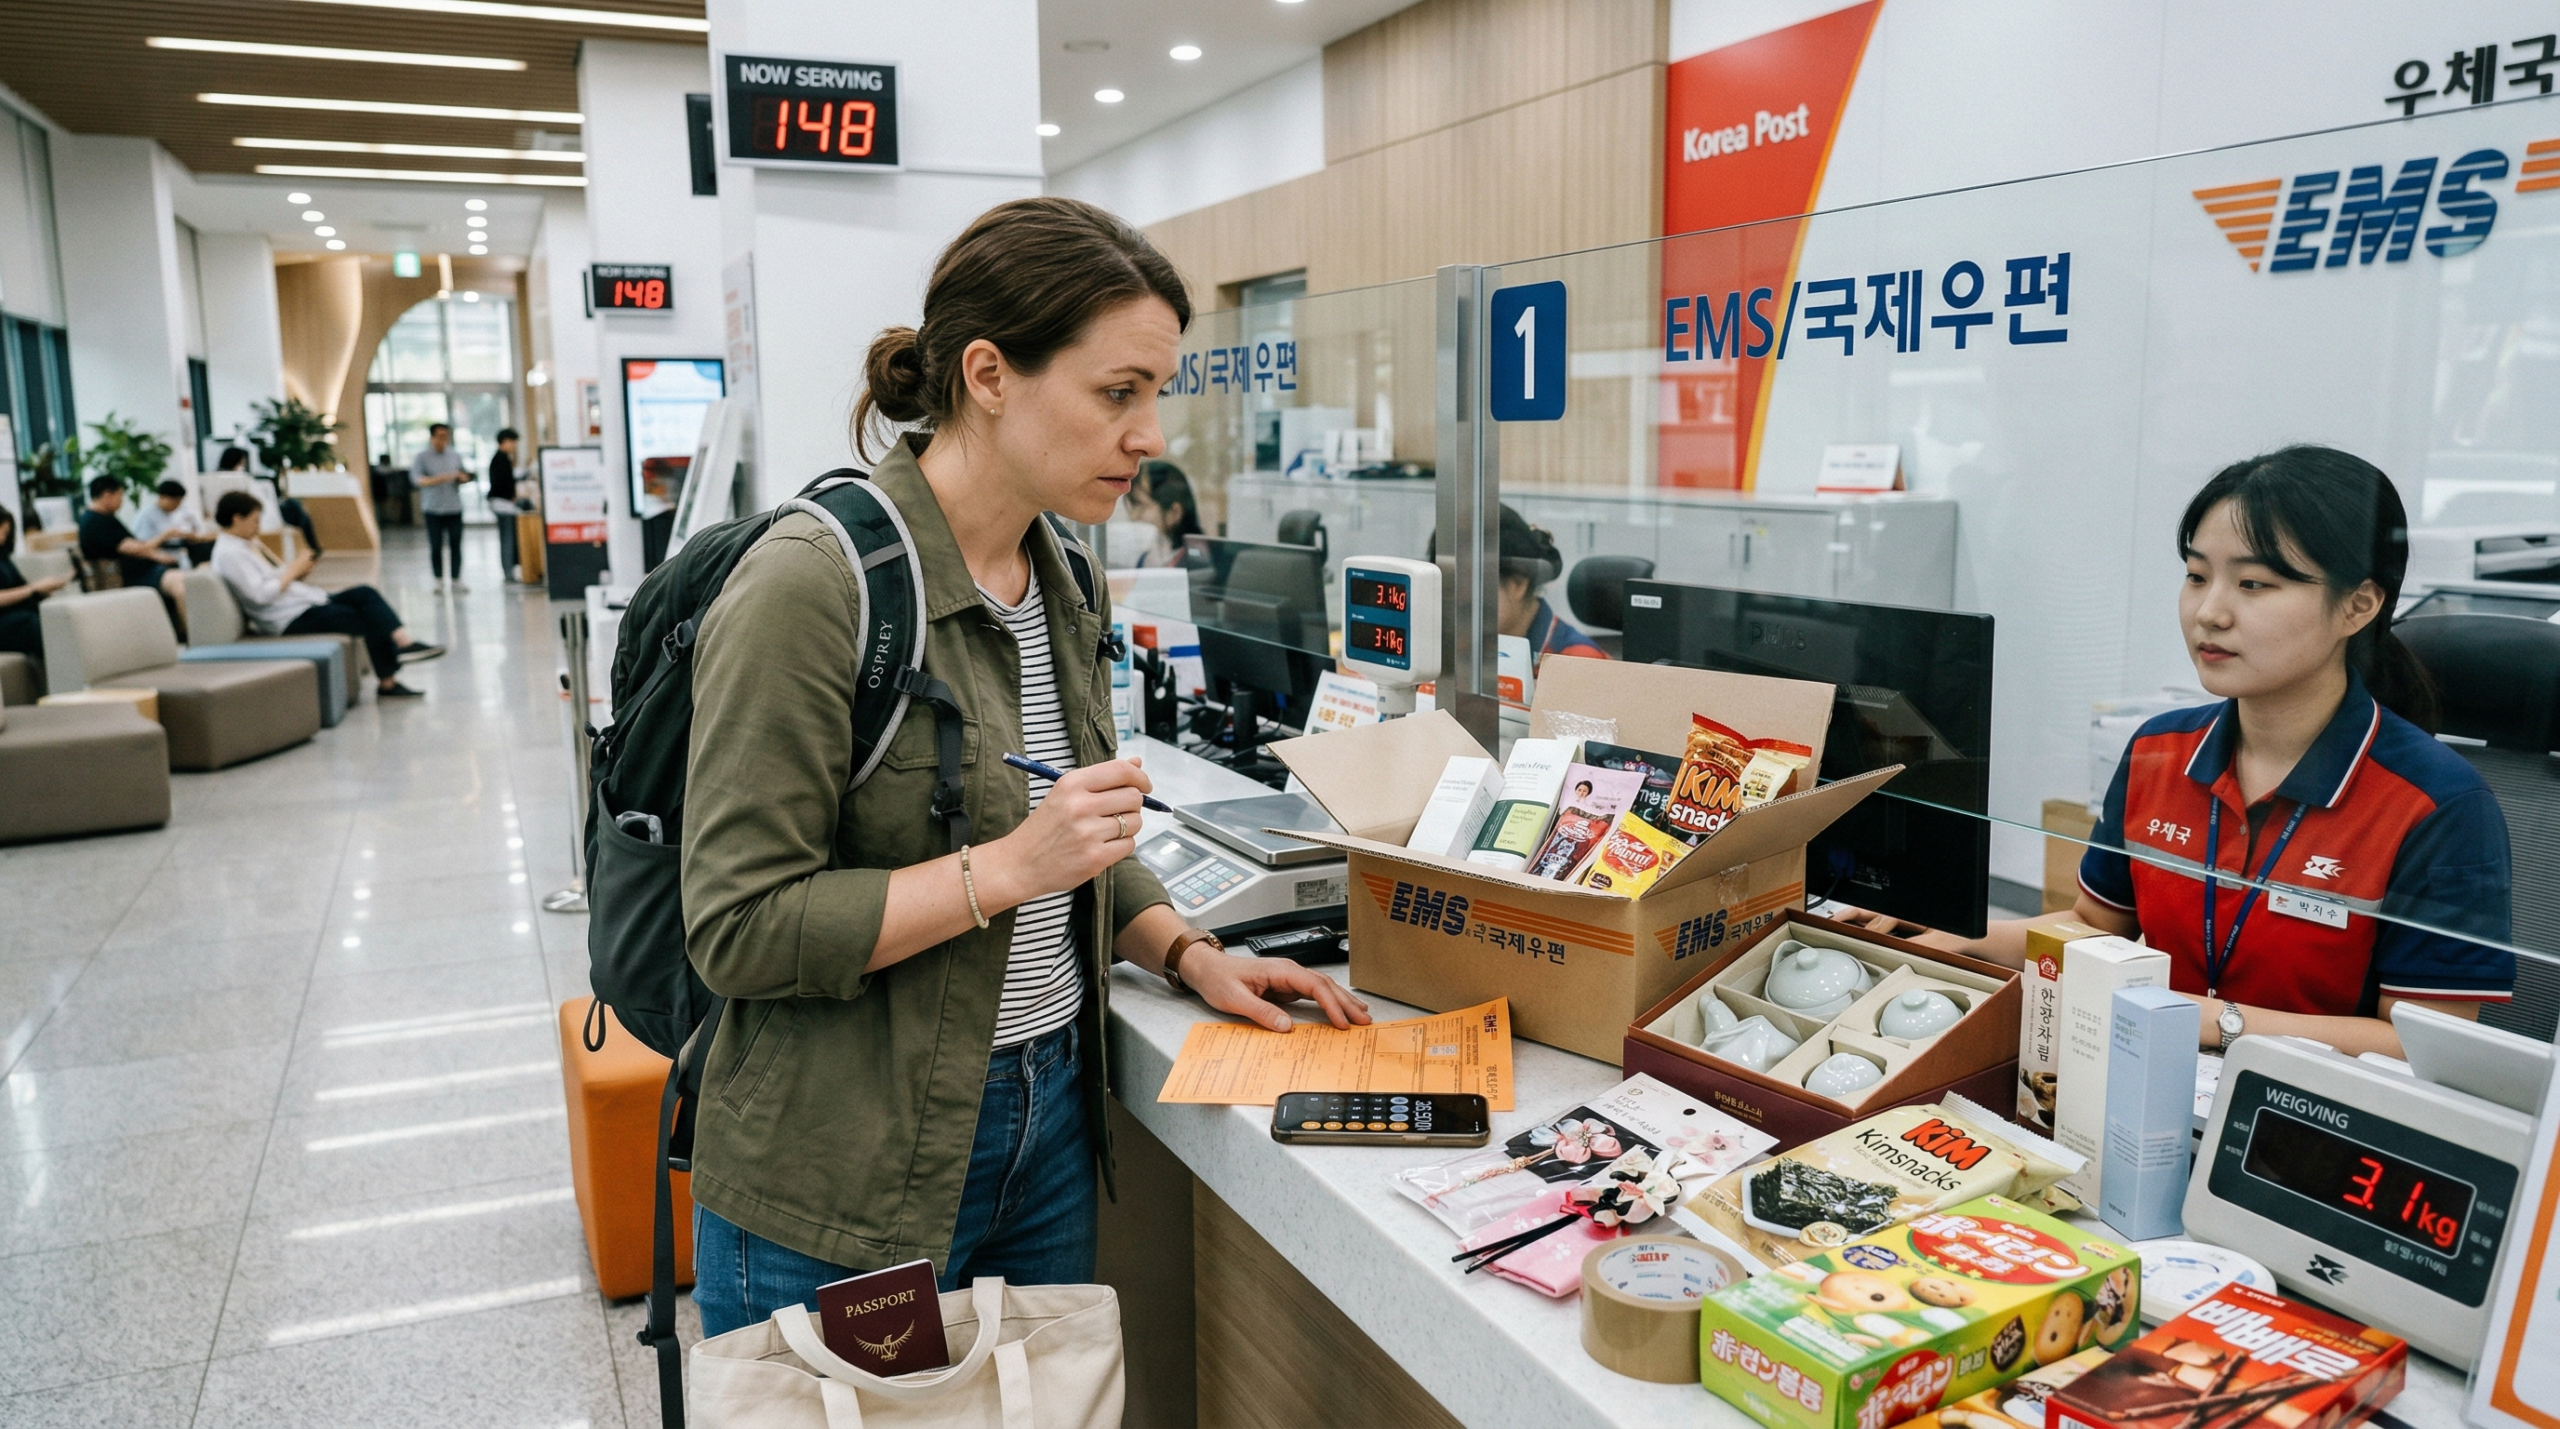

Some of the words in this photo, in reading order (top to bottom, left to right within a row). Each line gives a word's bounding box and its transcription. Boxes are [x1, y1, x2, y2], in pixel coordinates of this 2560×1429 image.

[740, 63, 791, 86] NOW
[794, 66, 883, 92] SERVING
[2385, 34, 2560, 116] 우체국
[775, 99, 876, 156] 148
[1683, 123, 1749, 163] Korea
[1754, 102, 1810, 147] Post
[2269, 148, 2509, 273] EMS
[614, 279, 665, 309] 148
[1170, 341, 1297, 397] MS/국제우편
[1514, 305, 1535, 399] 1
[868, 620, 893, 689] OSPREY
[1390, 881, 1469, 936] EMS
[1674, 908, 1728, 961] EMS
[1855, 1128, 1963, 1192] Kimsnacks
[845, 1288, 916, 1318] PASSPORT
